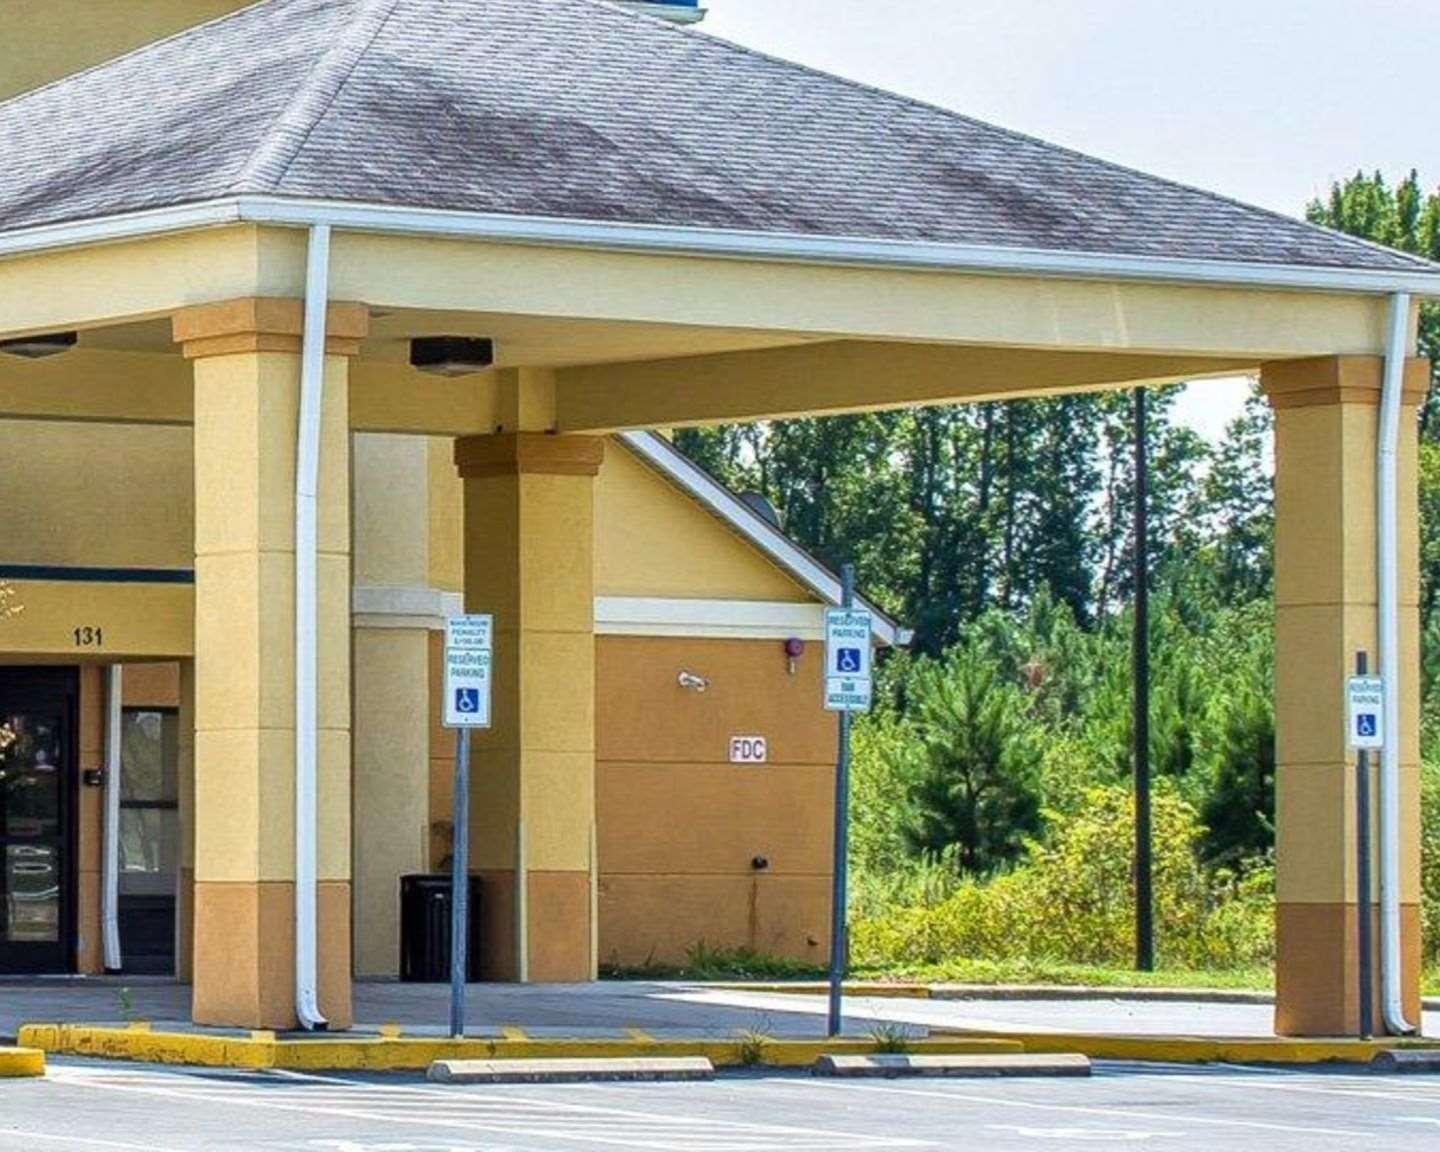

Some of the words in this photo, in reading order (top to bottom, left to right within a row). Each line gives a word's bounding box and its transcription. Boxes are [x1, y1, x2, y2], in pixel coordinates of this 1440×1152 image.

[73, 625, 102, 646] 131
[447, 654, 489, 666] RESERVED
[450, 667, 485, 679] PARKING
[732, 739, 764, 759] FDC
